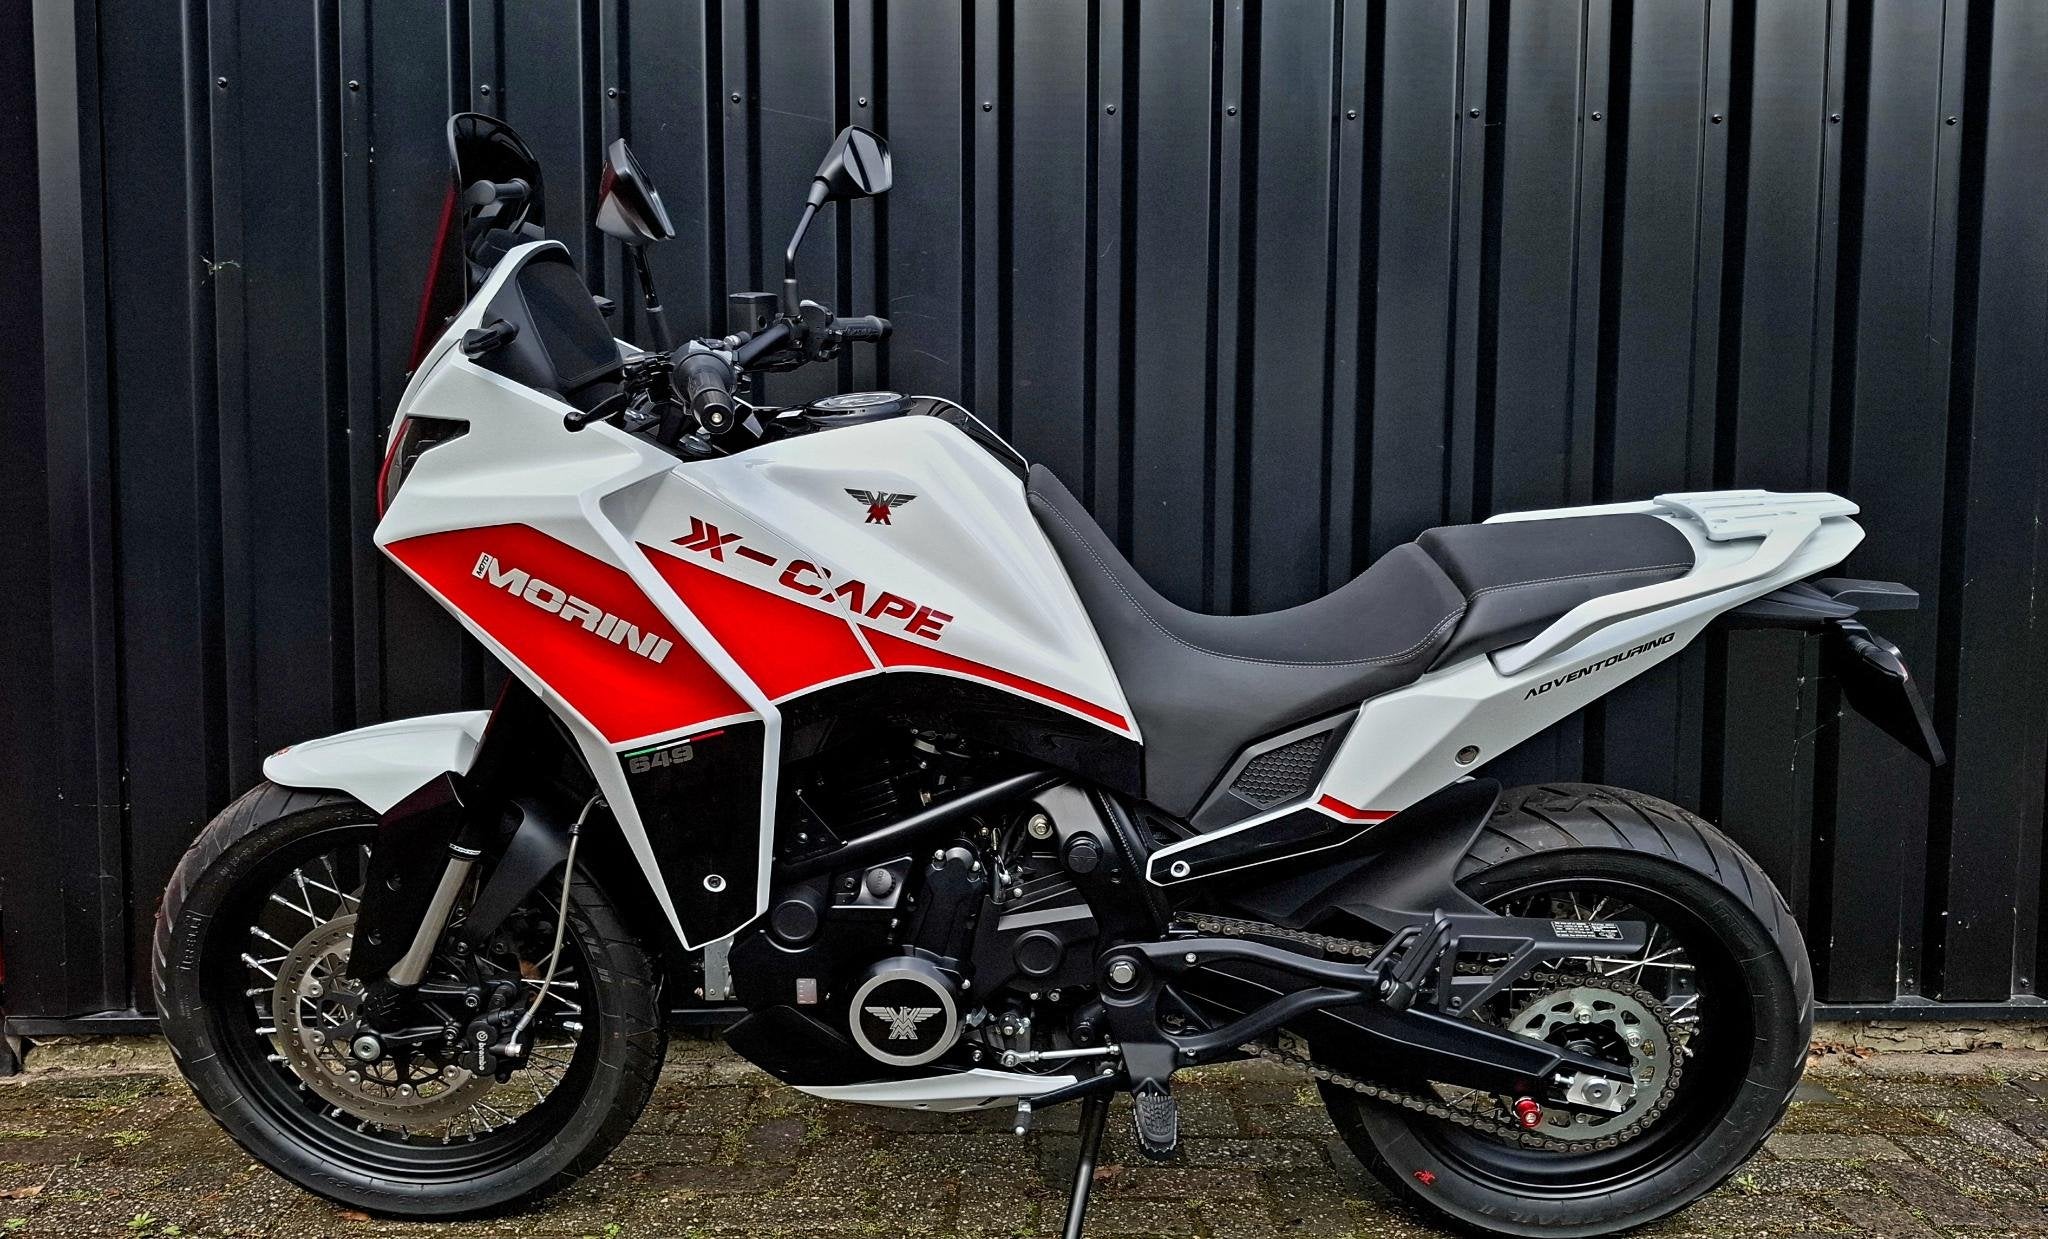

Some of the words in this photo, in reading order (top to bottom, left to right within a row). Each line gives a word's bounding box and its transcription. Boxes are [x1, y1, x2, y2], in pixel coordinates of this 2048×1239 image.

[475, 554, 490, 577] MOTO
[670, 515, 954, 642] X-CAPE
[488, 557, 674, 664] MORINI
[1523, 631, 1676, 701] ADVENTOURING
[629, 744, 694, 774] 649
